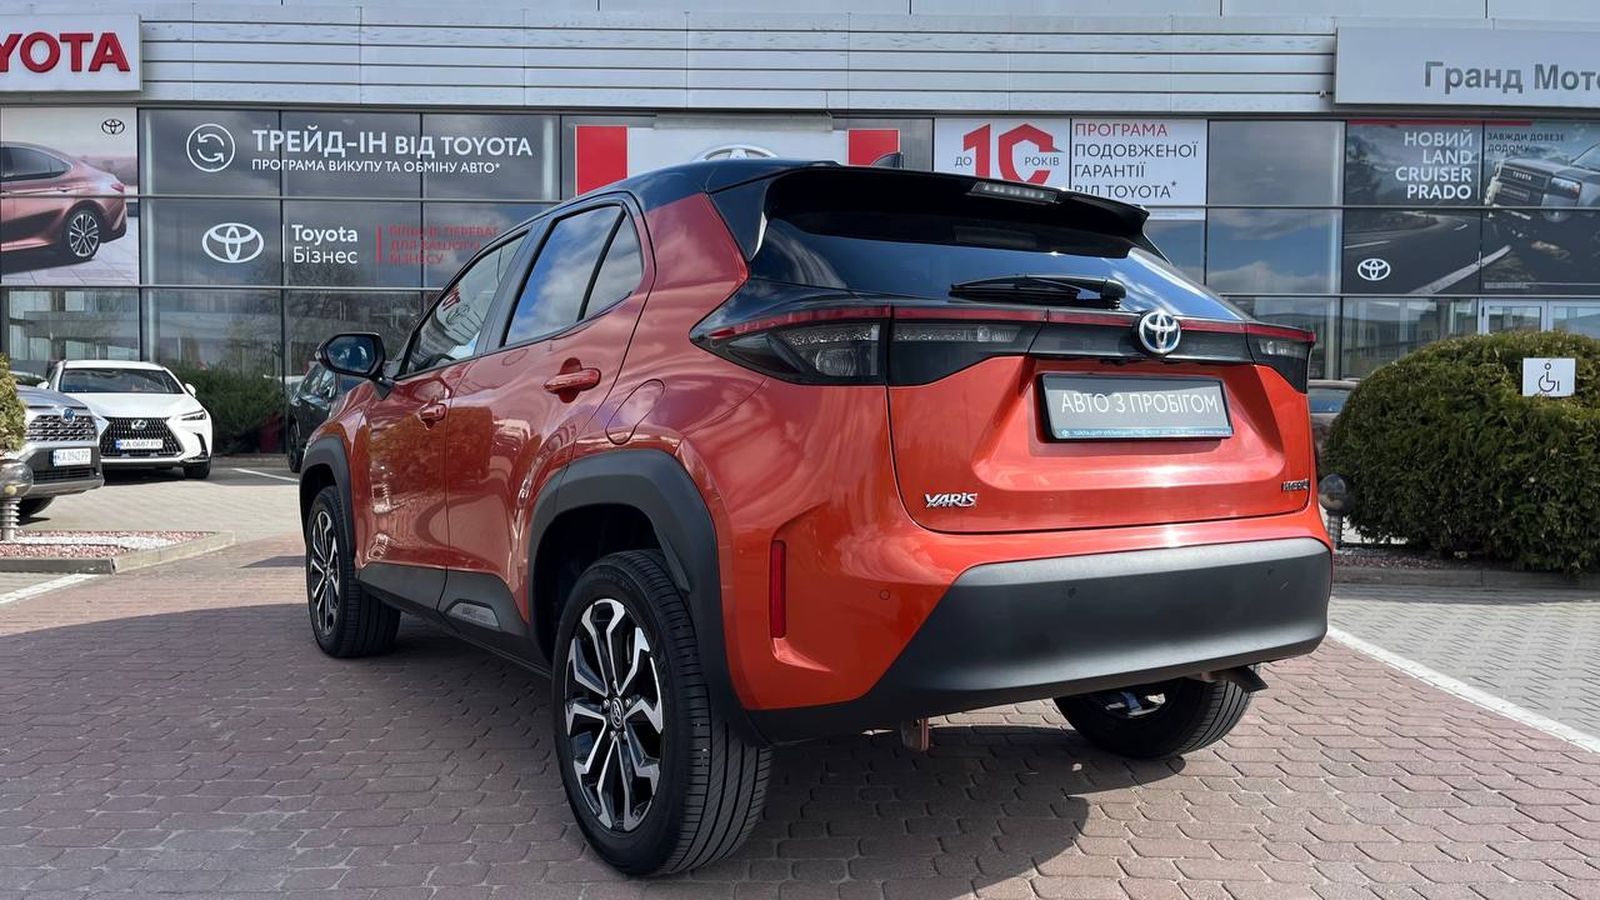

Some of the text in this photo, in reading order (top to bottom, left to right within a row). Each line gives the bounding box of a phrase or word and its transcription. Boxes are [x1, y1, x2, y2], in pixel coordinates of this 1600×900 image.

[0, 31, 131, 73] YOTA
[1424, 61, 1600, 95] Гранд Мот
[1074, 123, 1168, 137] ПРОГРАМА
[1404, 129, 1473, 147] НОВИЙ
[1487, 132, 1528, 143] ЗАВЖДИ
[252, 125, 533, 159] ТРЕЙД-ІН ВІД TOYOTA
[1074, 141, 1199, 160] ПОДОВЖЕНОЇ
[252, 158, 325, 171] ПРОГРАМА
[328, 160, 382, 172] ВИКУПУ
[385, 160, 401, 172] ТА
[403, 161, 457, 173] ОБМІНУ
[954, 156, 973, 168] ДО
[1024, 156, 1060, 167] РОКІВ
[1422, 150, 1472, 165] LAND
[1074, 161, 1146, 178] ГАРАНТІЇ
[1395, 166, 1472, 182] CRUISER
[1407, 184, 1472, 200] PRADO
[291, 224, 358, 246] Toyota
[293, 246, 358, 264] Бізнес
[1062, 393, 1219, 413] АВТО З ПРОБІГОМ
